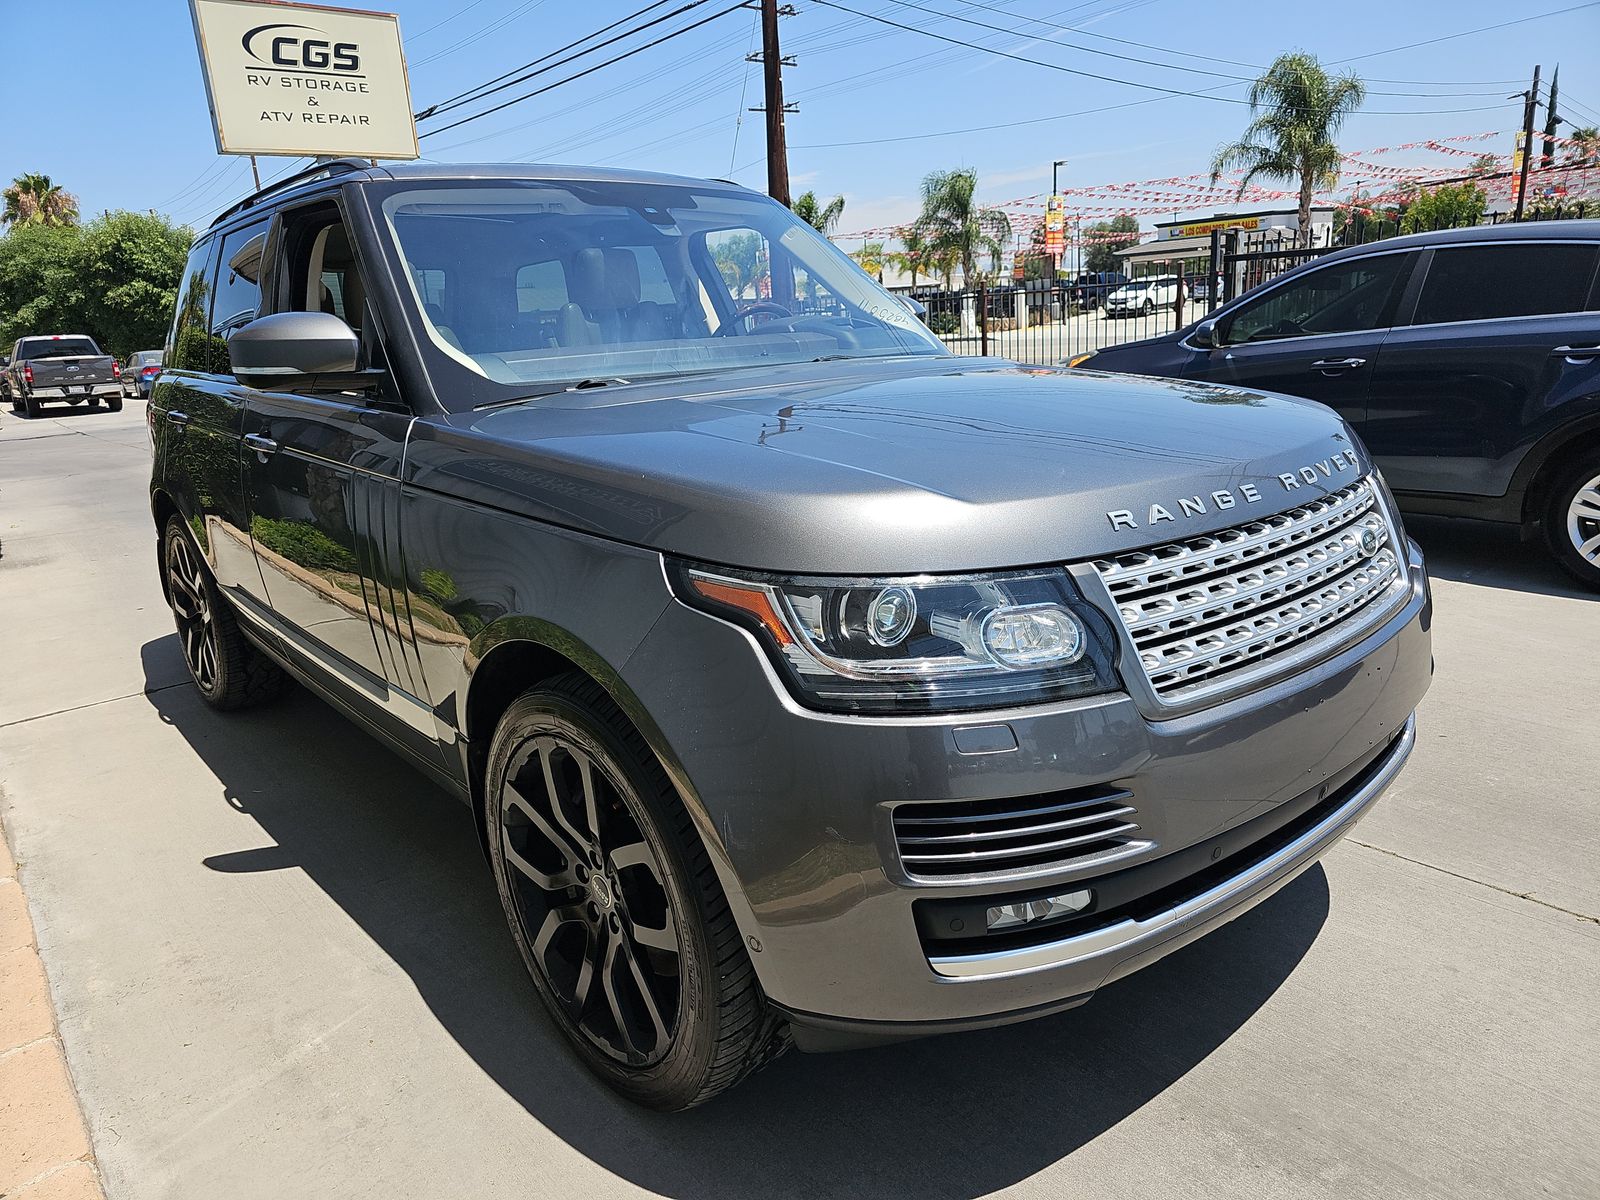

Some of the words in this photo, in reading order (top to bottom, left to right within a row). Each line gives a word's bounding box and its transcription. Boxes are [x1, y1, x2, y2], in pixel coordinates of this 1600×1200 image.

[272, 36, 360, 72] CGS
[247, 74, 272, 86] RV
[280, 77, 369, 93] STORAGE
[307, 96, 320, 107] &
[260, 111, 293, 123] ATV
[303, 113, 370, 126] REPAIR
[1185, 226, 1195, 236] LOS
[1105, 482, 1263, 532] RANGE
[1277, 448, 1360, 492] ROVER
